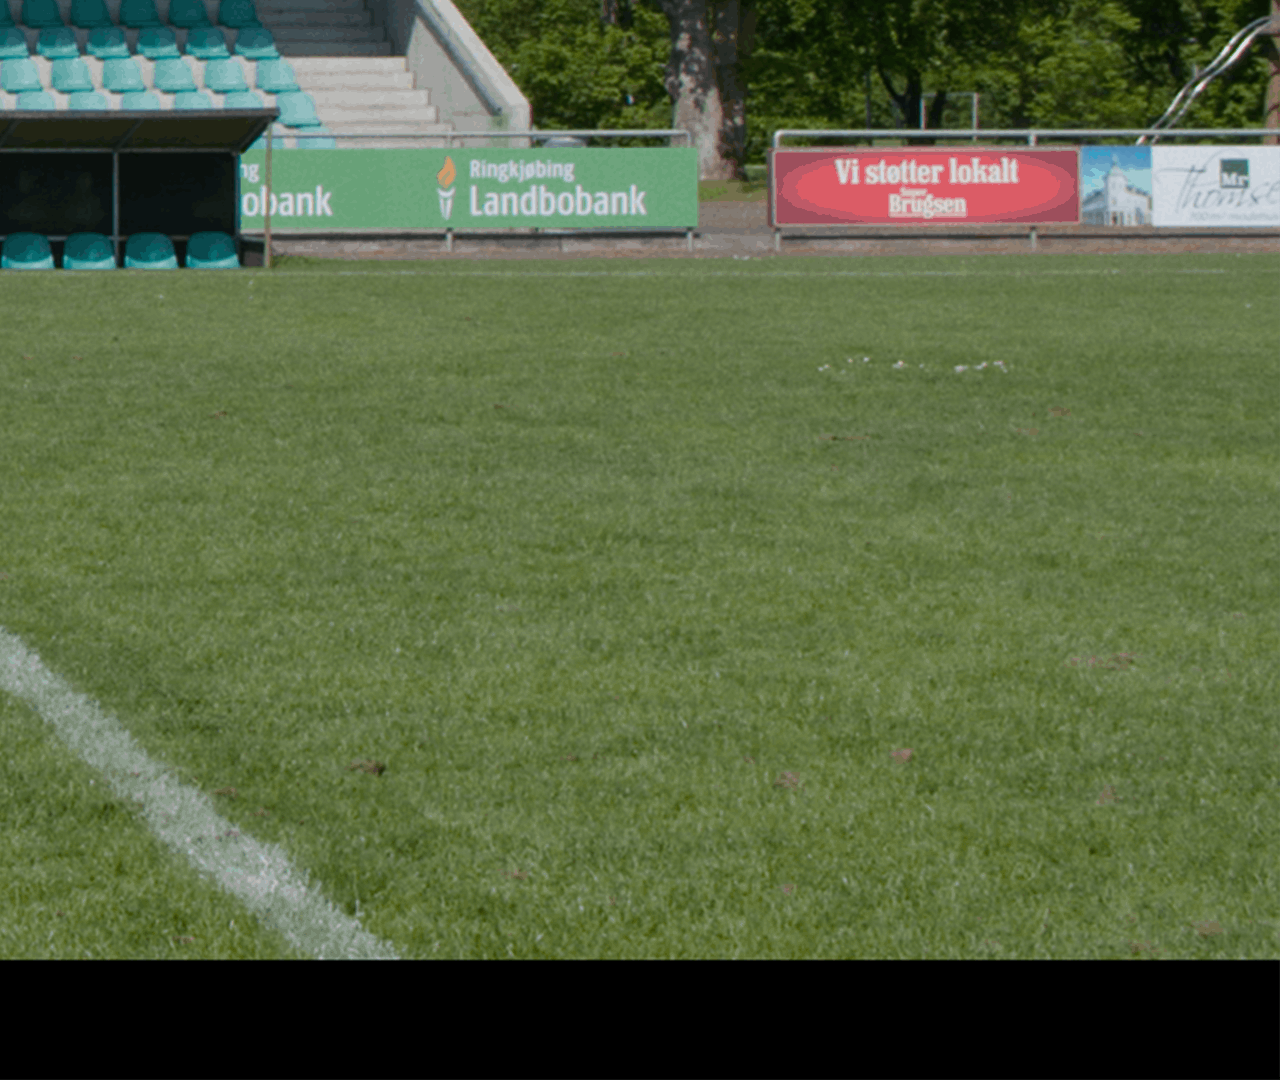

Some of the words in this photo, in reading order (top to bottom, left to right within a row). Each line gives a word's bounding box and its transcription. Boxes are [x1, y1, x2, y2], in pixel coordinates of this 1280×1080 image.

[470, 159, 575, 183] Ringkjøbing
[834, 158, 860, 185] Vi
[864, 159, 944, 185] støtter
[948, 156, 1020, 185] lokalt
[470, 185, 647, 217] Landbobank
[888, 192, 968, 219] Brugsen
